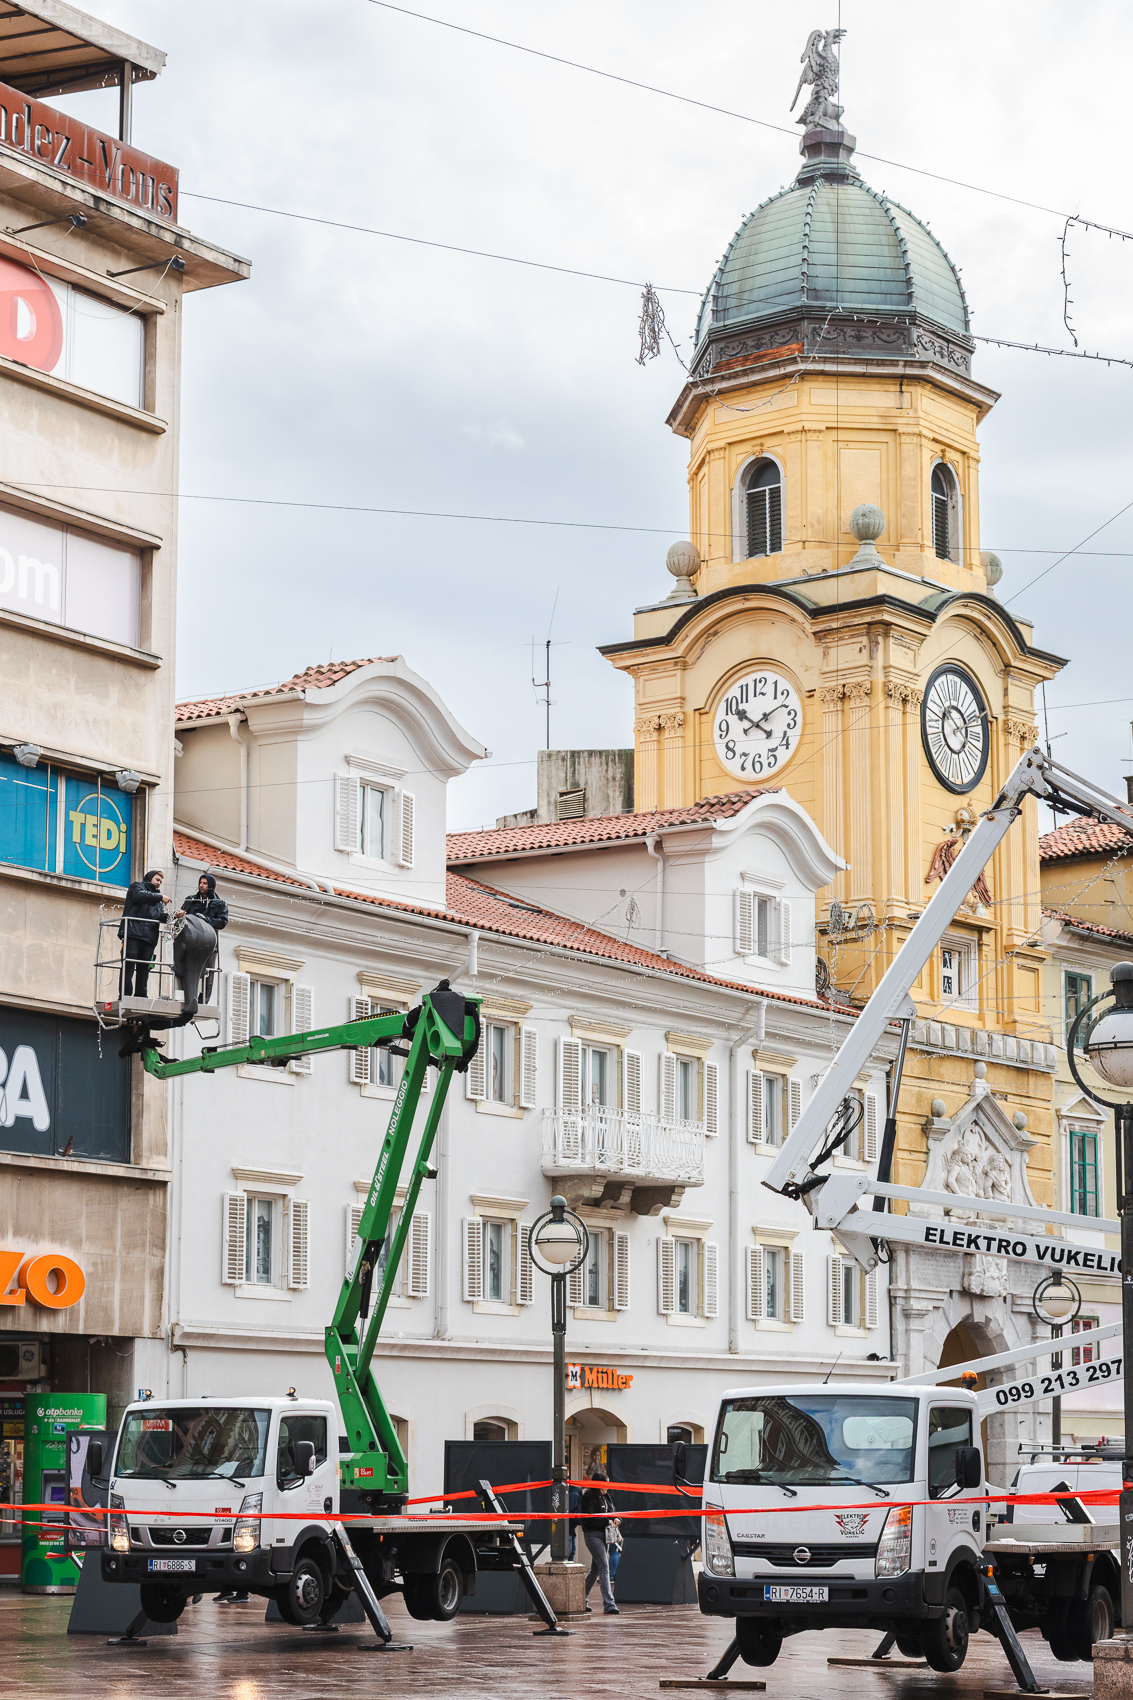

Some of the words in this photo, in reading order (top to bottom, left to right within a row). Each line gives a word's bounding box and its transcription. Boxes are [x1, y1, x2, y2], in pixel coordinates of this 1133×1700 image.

[738, 682, 749, 704] 11
[752, 676, 768, 698] 12
[772, 680, 778, 700] 1
[724, 696, 739, 716] 10
[780, 689, 790, 709] 2
[718, 719, 730, 740] 9
[786, 708, 798, 730] 3
[725, 739, 736, 760] 8
[779, 730, 791, 750] 4
[740, 752, 750, 772] 7
[752, 753, 763, 774] 6
[767, 746, 778, 768] 5
[69, 810, 127, 854] TEDi
[0, 1044, 50, 1132] A
[389, 1080, 408, 1136] NOLEGGIO
[370, 1190, 378, 1207] OIL
[378, 1152, 389, 1182] STEEL
[924, 1226, 1027, 1257] ELEKTRO
[584, 1366, 634, 1389] Müller
[996, 1382, 1034, 1405] 099
[1040, 1370, 1080, 1394] 213
[1086, 1358, 1122, 1382] 297
[46, 1407, 83, 1417] otpbanka
[154, 1561, 161, 1569] RI
[166, 1561, 192, 1569] 6886-S
[772, 1588, 782, 1598] RI
[790, 1588, 824, 1598] 7654-R
